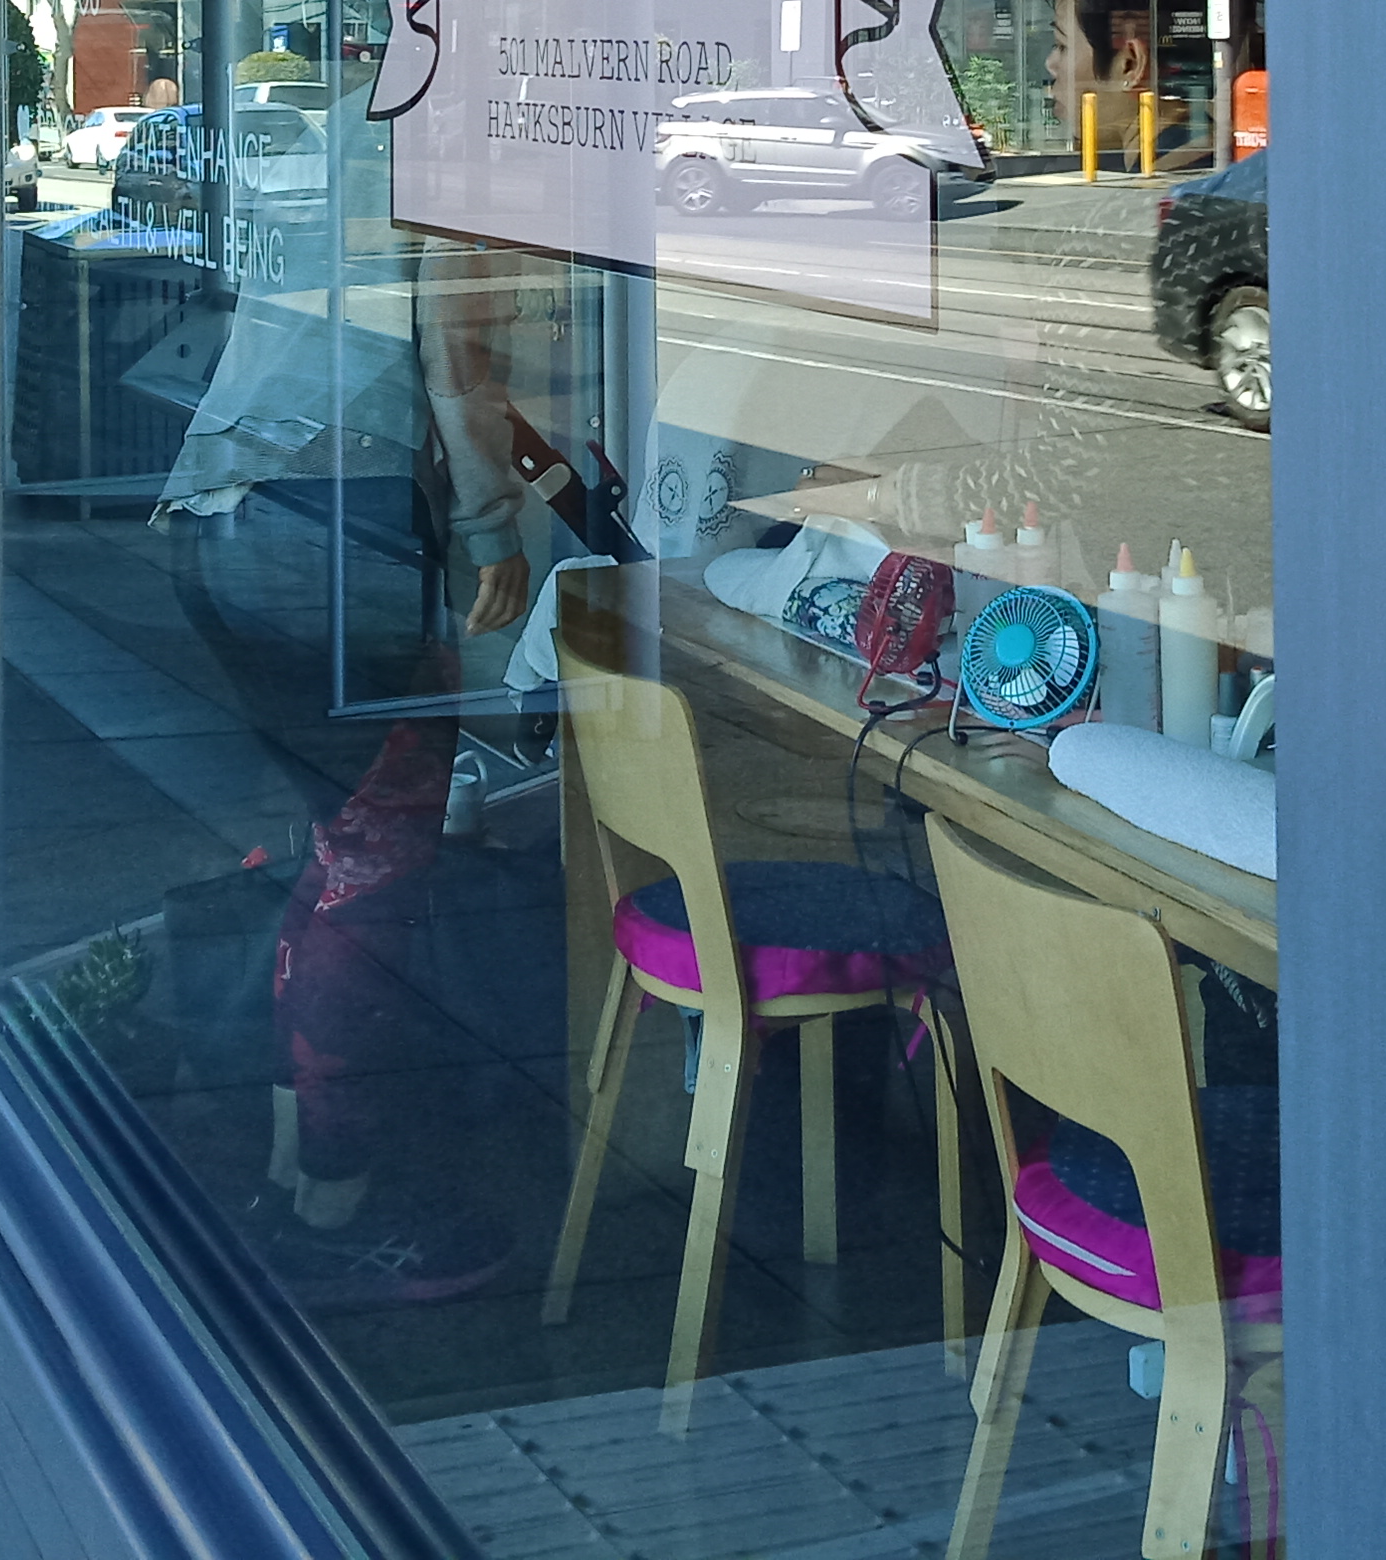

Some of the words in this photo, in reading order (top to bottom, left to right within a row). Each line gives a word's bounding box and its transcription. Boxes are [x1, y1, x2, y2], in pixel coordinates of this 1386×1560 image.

[498, 37, 529, 77] 501
[534, 38, 650, 83] MALVERN
[487, 99, 626, 152] HAWKSBURN
[175, 125, 274, 193] ENHANCE
[162, 203, 218, 271] WELL
[222, 214, 287, 286] BEING
